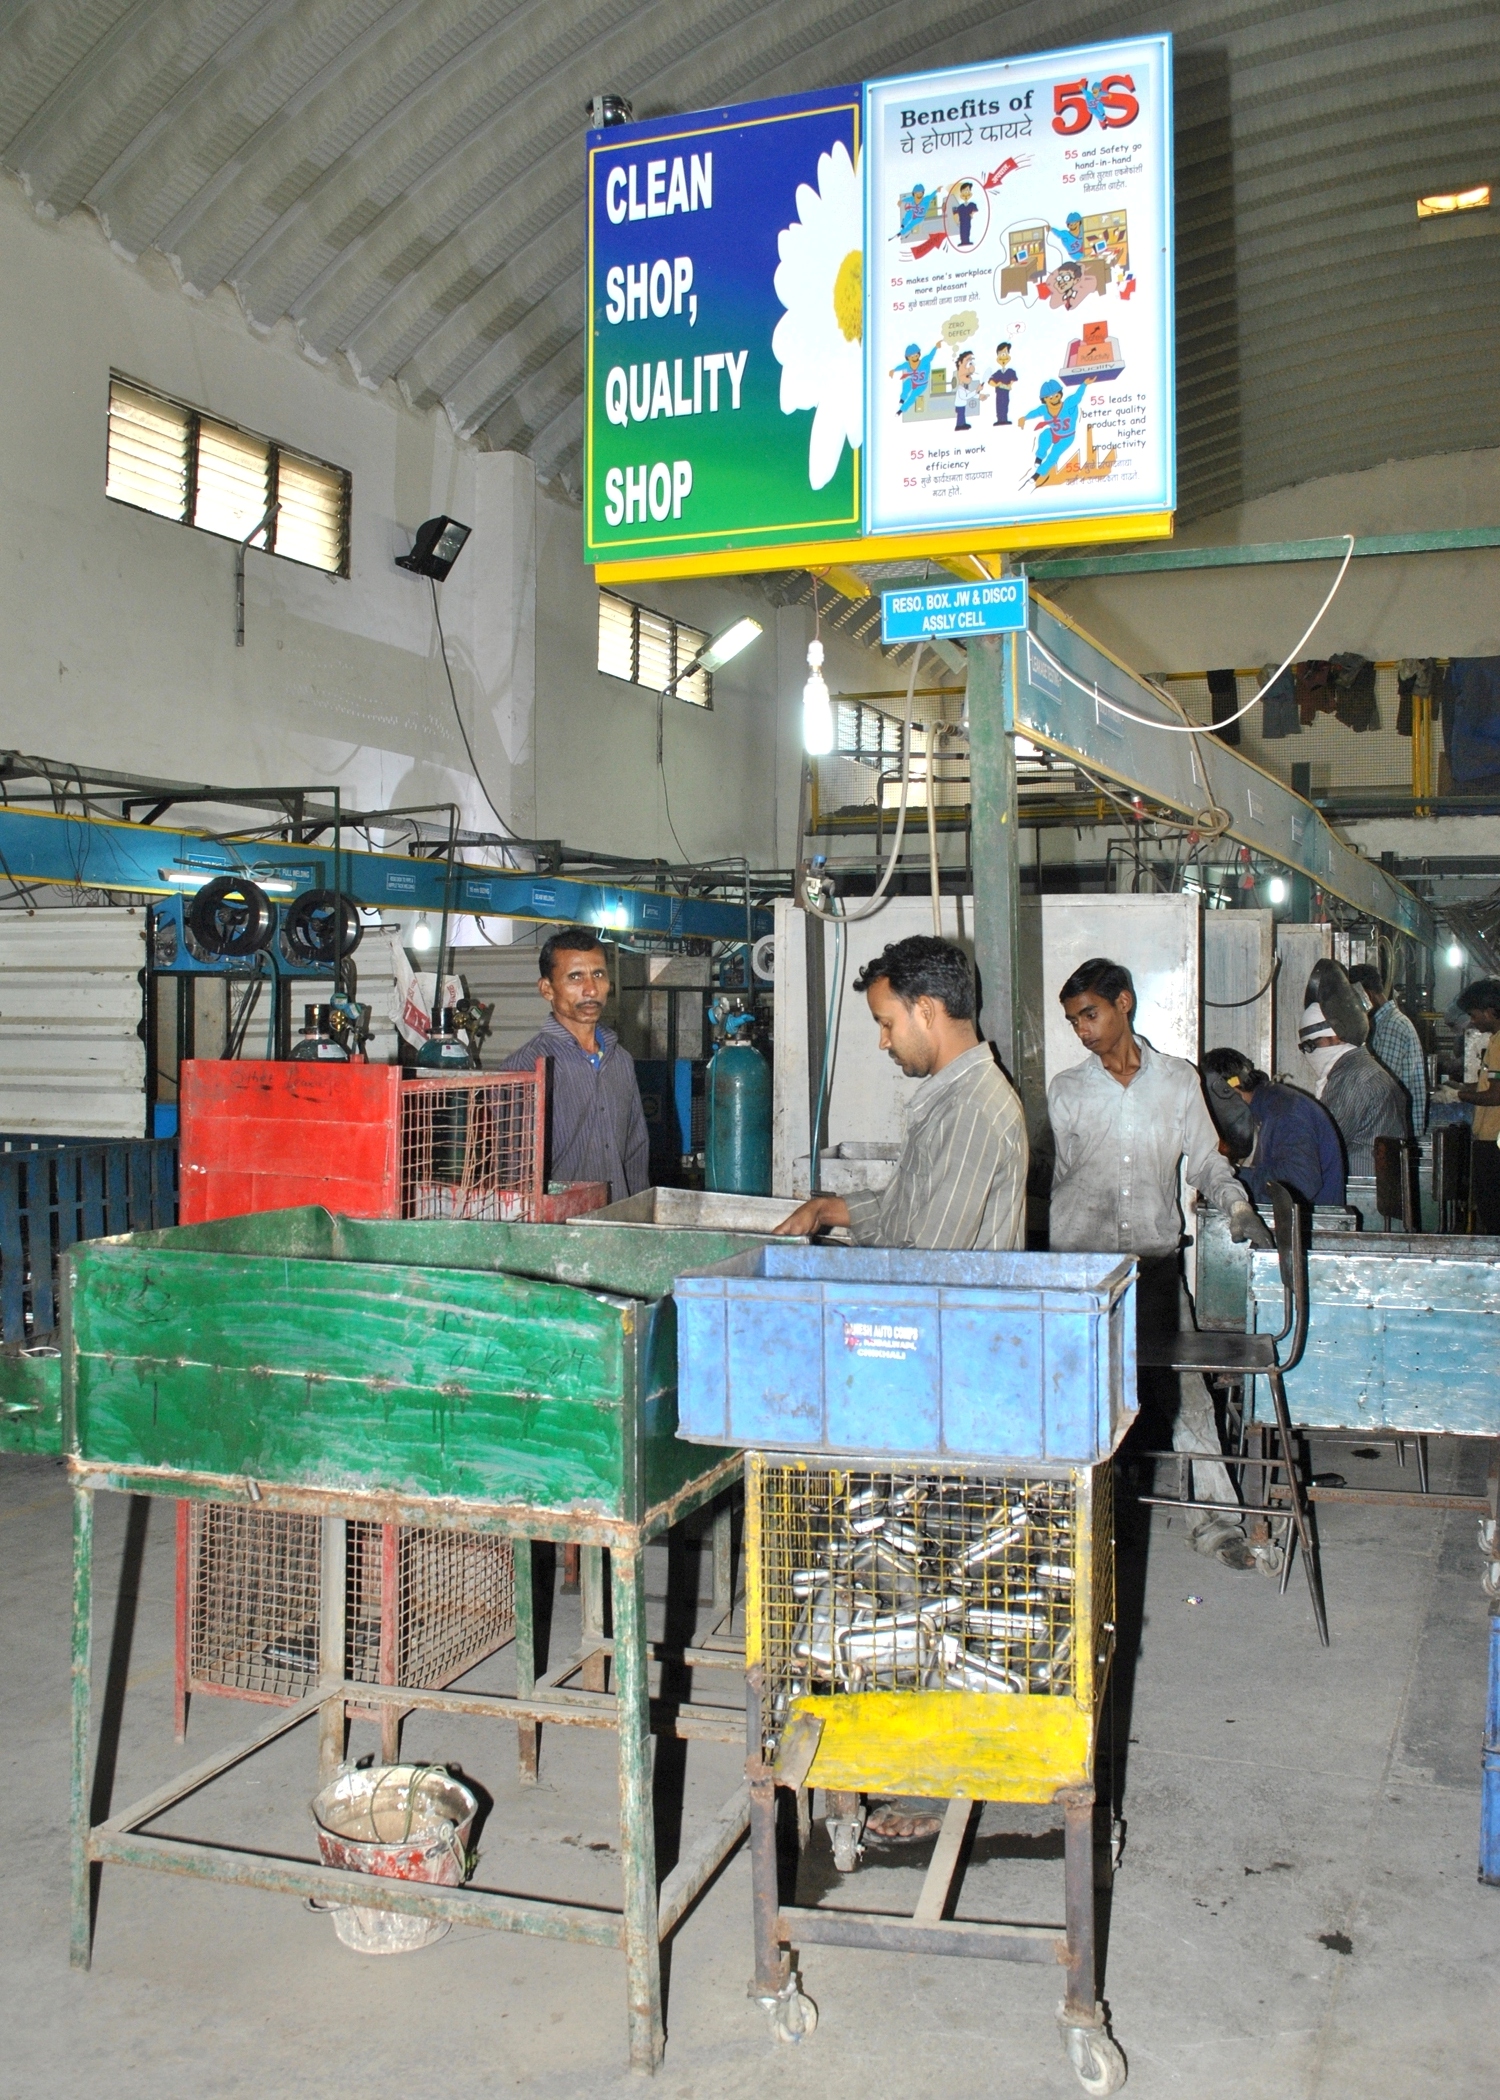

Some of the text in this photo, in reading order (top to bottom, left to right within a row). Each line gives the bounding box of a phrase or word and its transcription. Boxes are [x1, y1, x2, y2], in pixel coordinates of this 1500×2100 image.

[900, 90, 1034, 129] Benefits of
[1052, 74, 1140, 136] 5S
[900, 113, 1034, 155] चे होणारे फायदे
[1064, 143, 1142, 160] 5S and Safety go
[1075, 155, 1132, 169] hand-in-hand
[1062, 174, 1076, 184] 5S
[606, 151, 713, 225] CLEAN
[891, 268, 992, 287] 5S makes one's workplace
[605, 256, 698, 328] SHOP,
[936, 282, 967, 293] pleasant
[893, 302, 905, 311] 5S
[948, 321, 965, 329] ZERO
[948, 329, 971, 338] DEFECT
[1071, 363, 1116, 373] Quality
[912, 371, 927, 381] 5S
[605, 350, 749, 428] QUALITY
[1090, 393, 1146, 406] 5S leads to
[1082, 405, 1146, 419] better quality
[1053, 417, 1071, 432] 5S
[1087, 415, 1146, 431] products and
[1117, 428, 1146, 439] higher
[910, 444, 986, 460] 5S helps in work
[1092, 439, 1146, 454] productivity
[926, 461, 970, 471] efficiency
[1065, 462, 1080, 473] 5S
[903, 477, 917, 487] 5S
[604, 460, 693, 526] SHOP
[892, 586, 1017, 613] RESO. BOX. JW & DISCO
[922, 611, 986, 632] ASSLY CELL
[873, 1325, 892, 1338] AUTO
